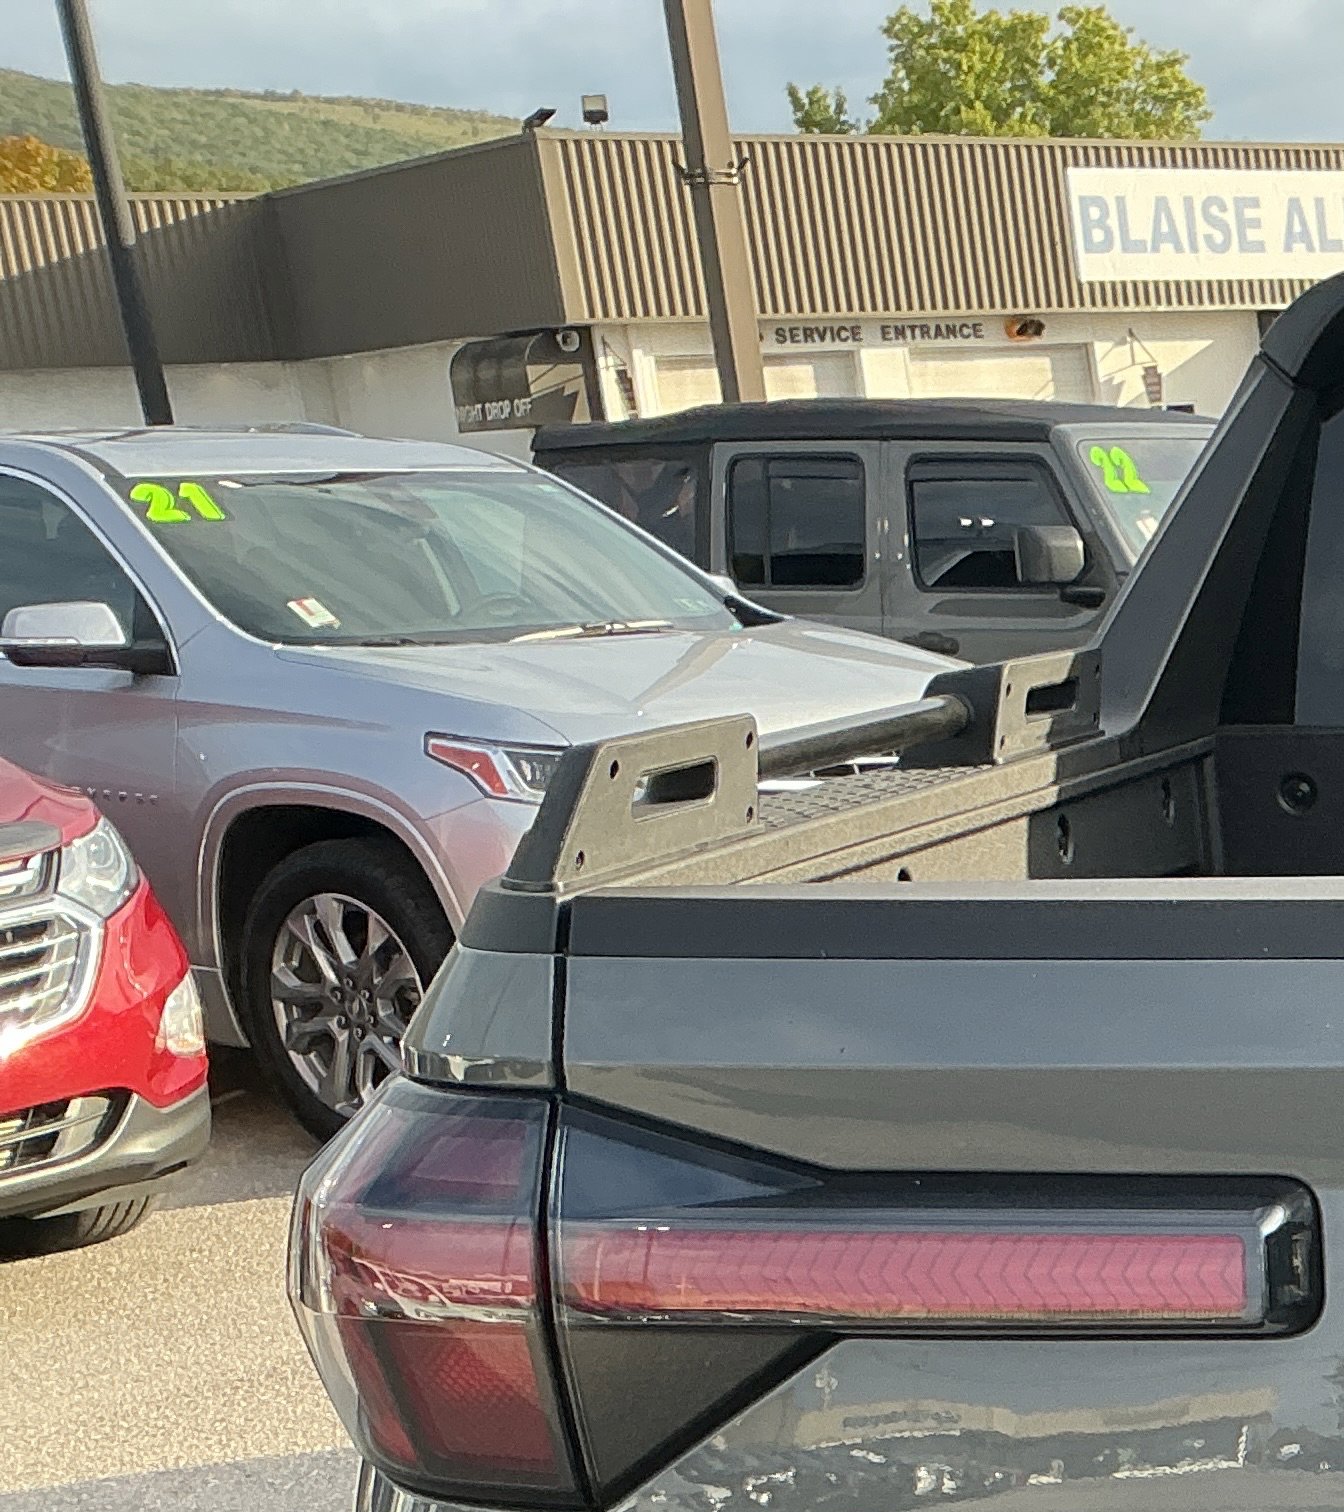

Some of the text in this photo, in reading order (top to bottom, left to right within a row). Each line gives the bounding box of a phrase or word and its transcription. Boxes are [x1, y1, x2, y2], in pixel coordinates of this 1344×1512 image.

[1078, 195, 1266, 254] BLAISE
[775, 325, 863, 344] SERVICE
[881, 322, 984, 342] ENTRANCE
[484, 400, 512, 421] DROP
[513, 397, 532, 418] OFF
[1089, 446, 1151, 494] 22
[129, 482, 226, 524] 21
